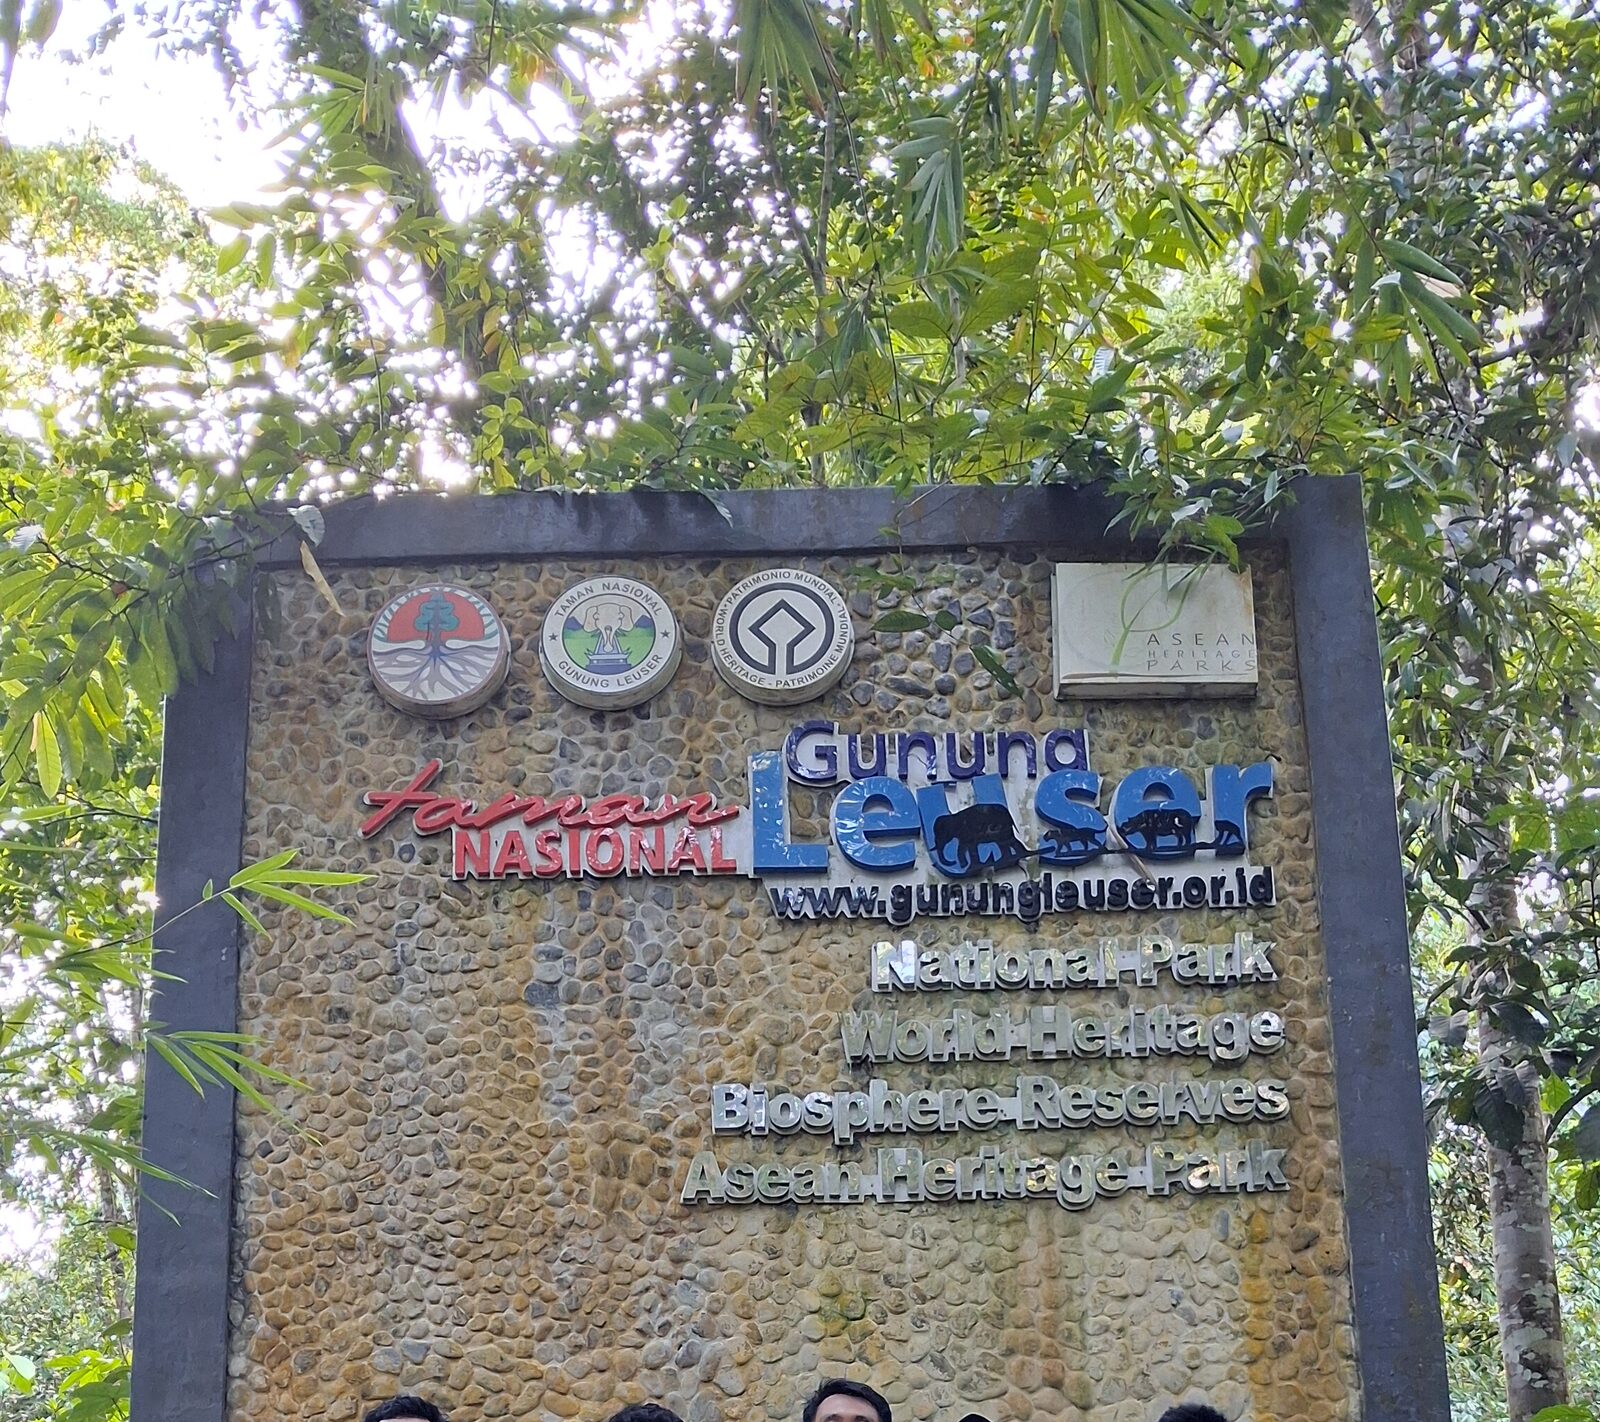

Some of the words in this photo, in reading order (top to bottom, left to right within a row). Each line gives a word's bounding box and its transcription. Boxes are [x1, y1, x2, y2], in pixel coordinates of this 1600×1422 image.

[554, 585, 594, 617] TAMAN
[602, 582, 663, 616] NASIONAL
[727, 571, 791, 605] PATRIMONIO
[794, 573, 838, 605] MUNDIAL
[715, 608, 729, 647] WORLD
[775, 655, 839, 688] PATRIMOINE
[835, 606, 849, 654] MUNDIAL
[1147, 632, 1255, 646] ASEAN
[558, 660, 609, 688] GUNUNG
[616, 653, 663, 687] LEUSER
[720, 645, 765, 686] HERITAGE
[1147, 659, 1257, 672] PARKS
[1149, 649, 1257, 659] HERITAGE
[753, 749, 1274, 878] Leuser
[454, 826, 738, 878] NASIONAL
[770, 866, 1273, 923] www.gunungleuser.or.id
[872, 938, 1119, 992] National
[1140, 932, 1278, 986] Park
[839, 1008, 1010, 1063] World
[1027, 1004, 1286, 1066] Heritage
[712, 1079, 1000, 1145] Biosphere
[1017, 1075, 1290, 1130] Reserves
[681, 1151, 863, 1205] Asean
[877, 1145, 1129, 1210] Heritage
[1147, 1139, 1290, 1195] Park
